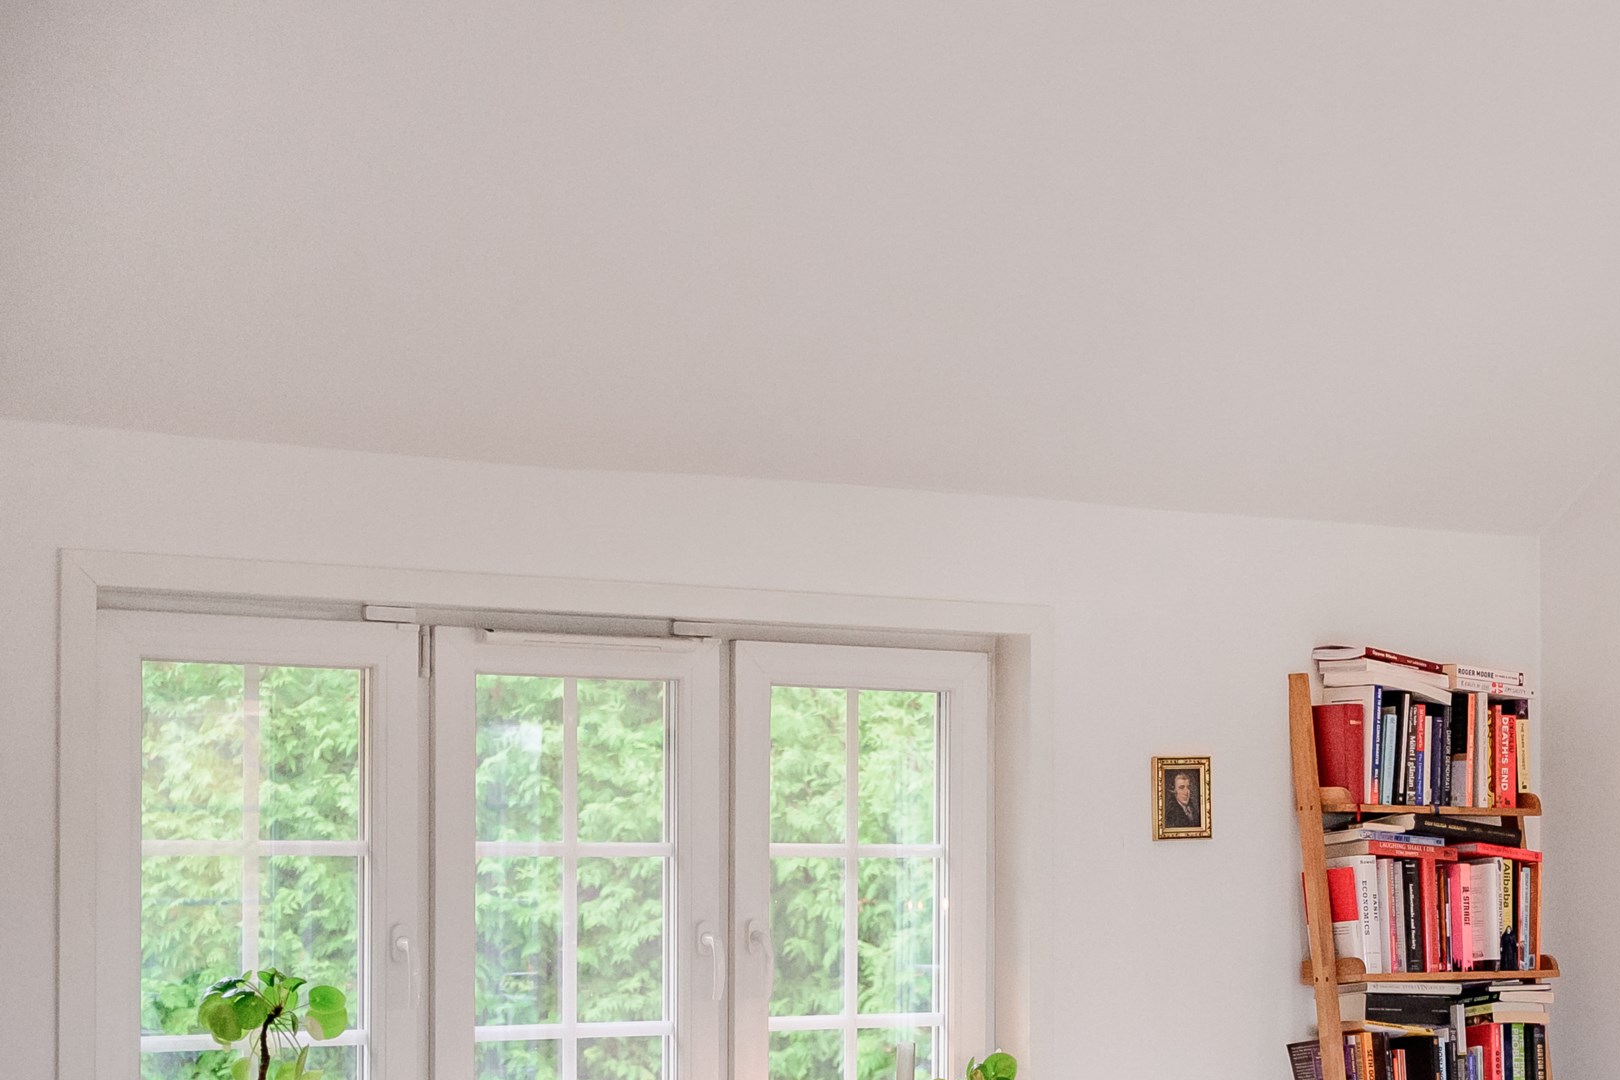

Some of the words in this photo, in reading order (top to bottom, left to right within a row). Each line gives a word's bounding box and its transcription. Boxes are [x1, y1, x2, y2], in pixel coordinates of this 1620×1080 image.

[1458, 668, 1475, 676] ROGER
[1408, 762, 1416, 787] gläntan
[1362, 880, 1370, 935] ECONOMICS
[1512, 1028, 1520, 1078] PROBLEM
